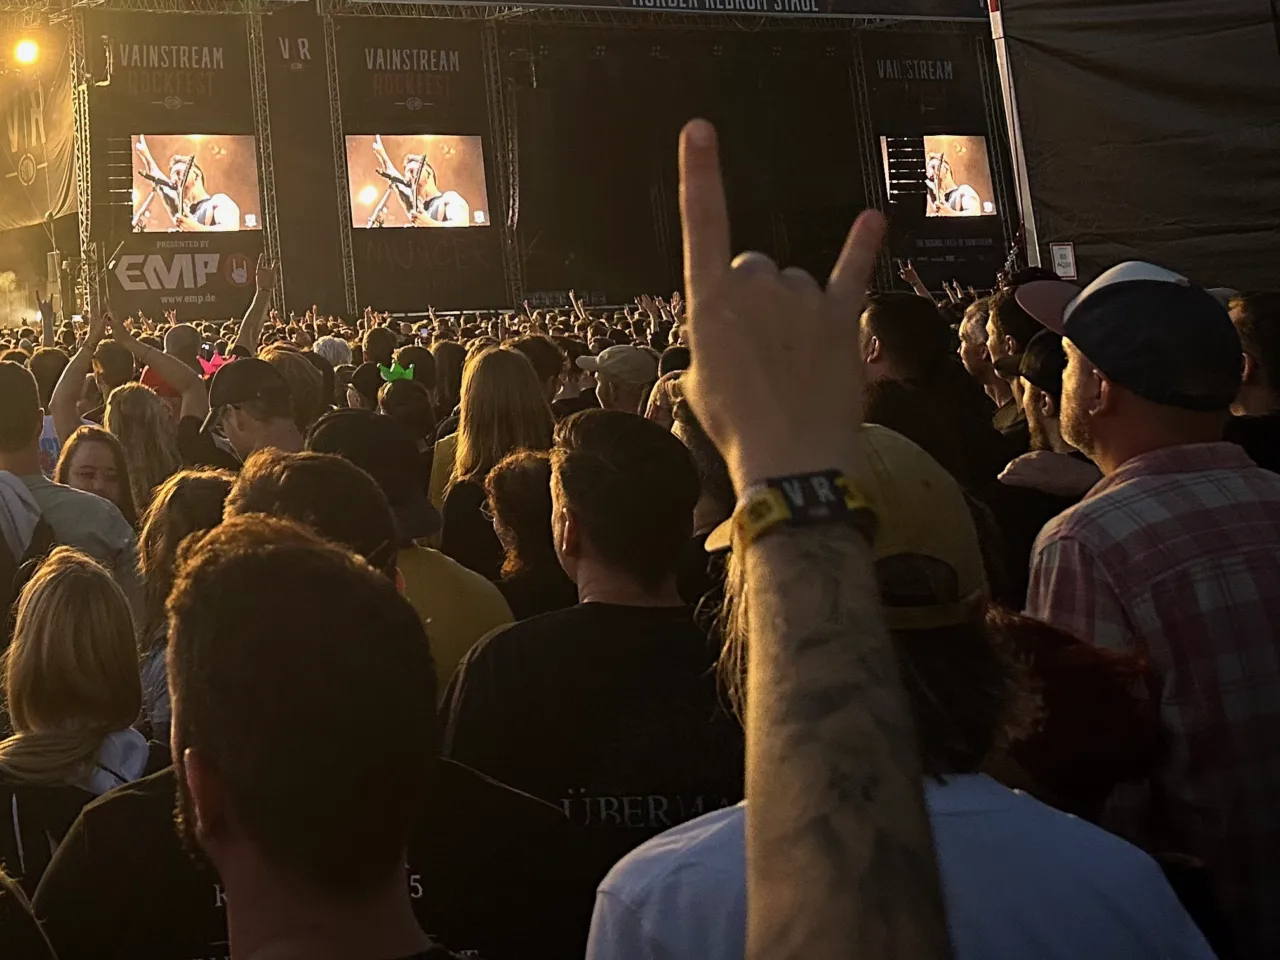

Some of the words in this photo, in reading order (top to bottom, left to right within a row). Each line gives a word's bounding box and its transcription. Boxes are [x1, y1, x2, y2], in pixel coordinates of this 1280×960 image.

[119, 43, 225, 70] VAINSTREAM
[364, 48, 461, 73] VAINSTREAM
[127, 70, 215, 98] ROCKFEST
[155, 240, 199, 249] PRESENTED
[199, 240, 210, 248] BY
[114, 253, 221, 291] EMP
[160, 293, 217, 305] www.emp.de
